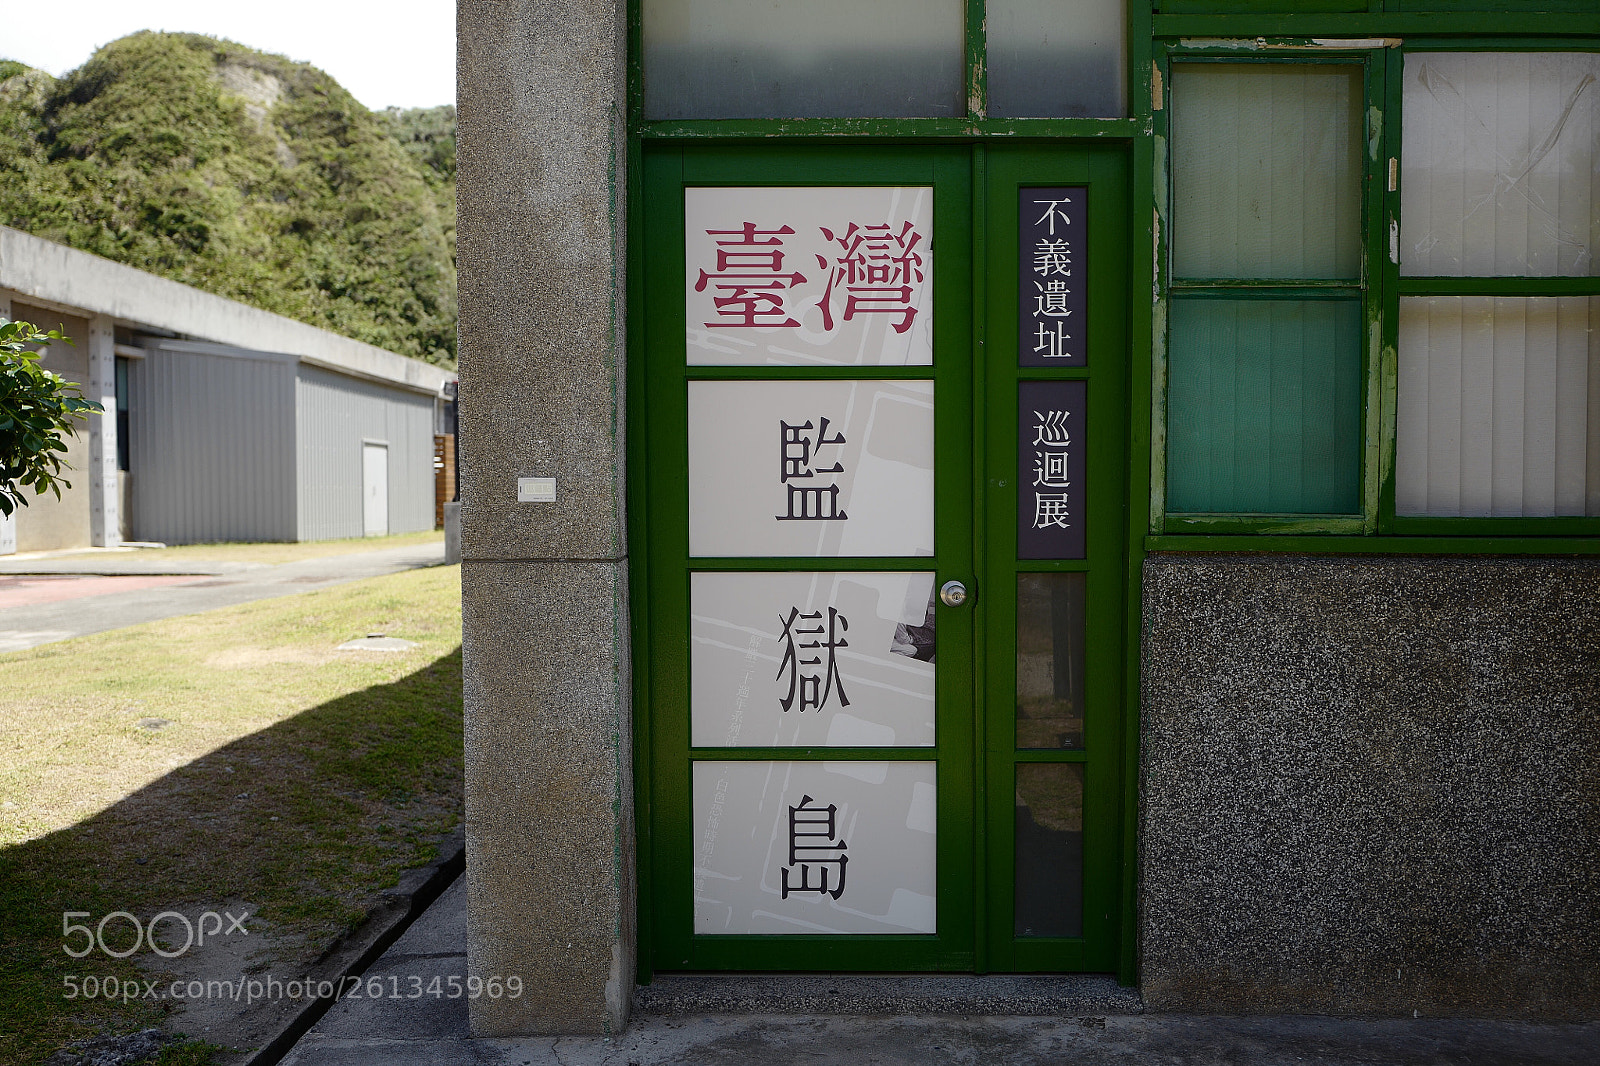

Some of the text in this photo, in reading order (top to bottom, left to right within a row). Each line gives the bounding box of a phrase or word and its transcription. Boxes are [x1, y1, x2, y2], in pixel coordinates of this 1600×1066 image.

[694, 220, 924, 334] 臺灣
[1032, 197, 1073, 358] 不義遺址
[774, 416, 849, 521] 監
[1031, 410, 1071, 529] 巡迴展
[775, 605, 851, 714] 獄
[780, 794, 849, 901] 島
